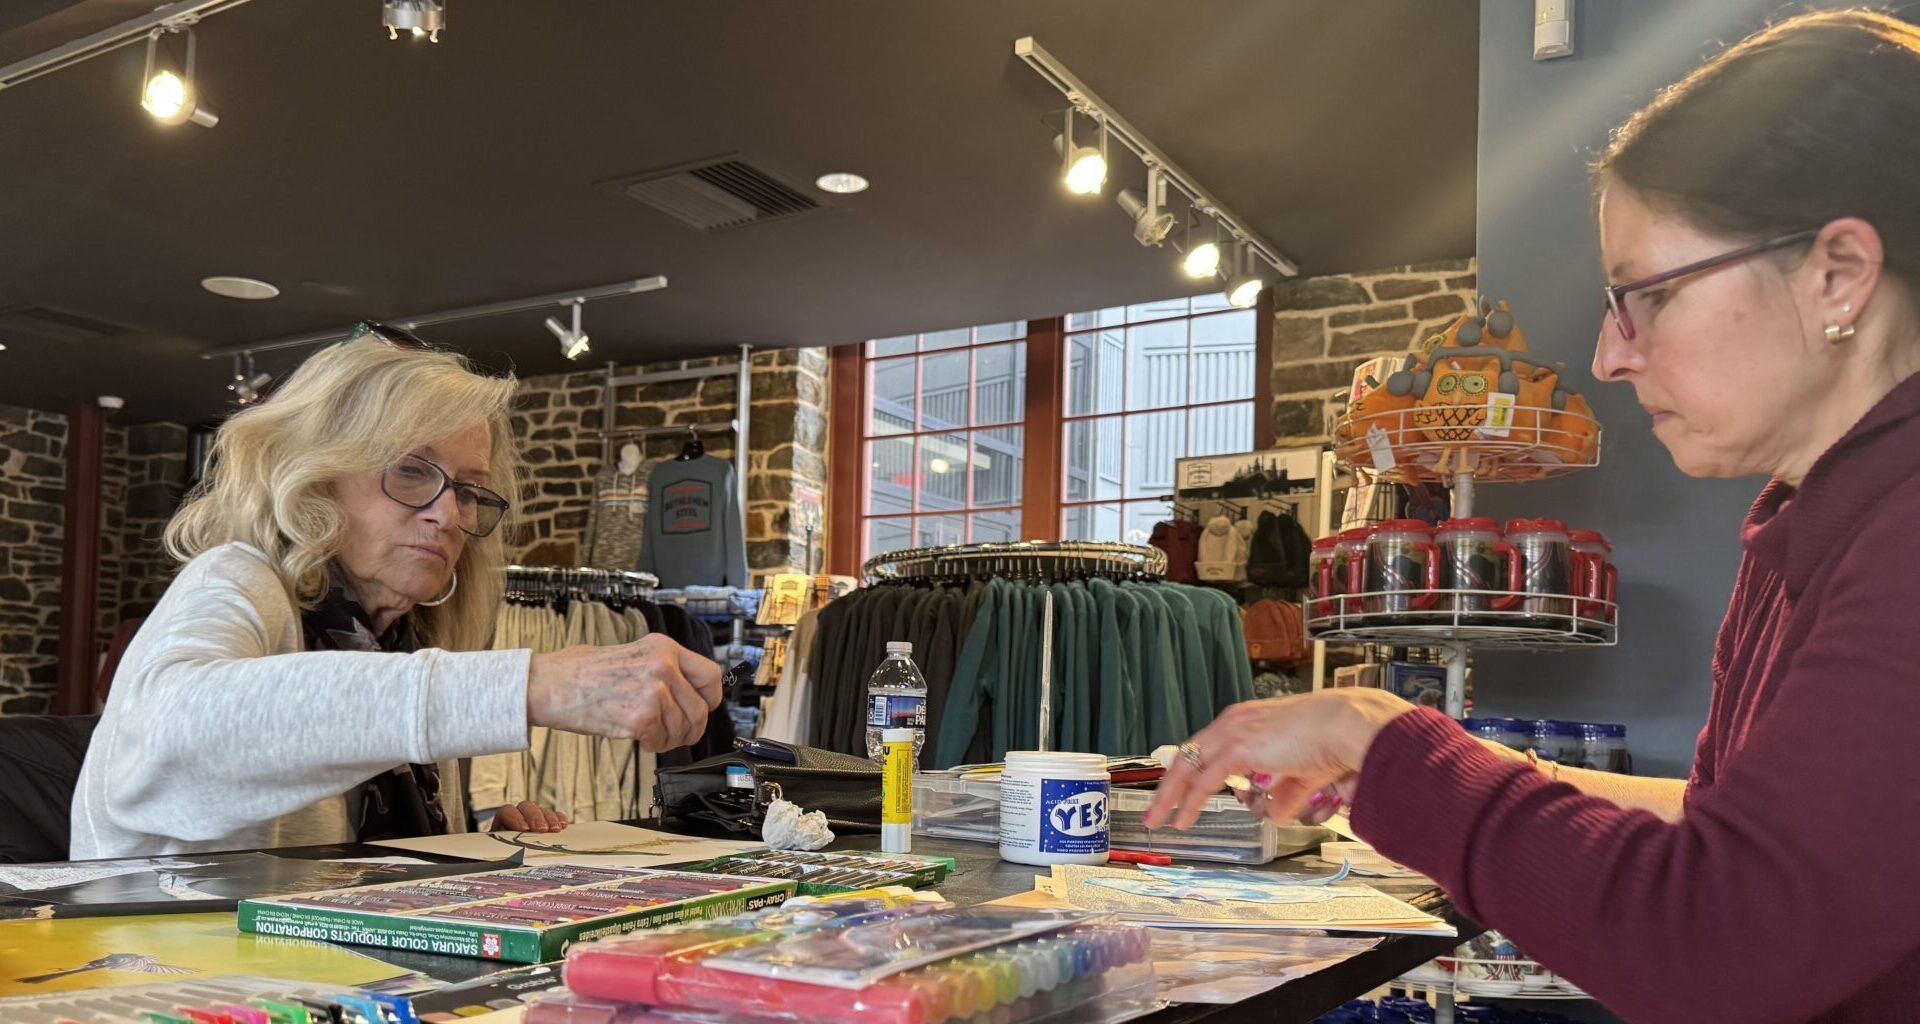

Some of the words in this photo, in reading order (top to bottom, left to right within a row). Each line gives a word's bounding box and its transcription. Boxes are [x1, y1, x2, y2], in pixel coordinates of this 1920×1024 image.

[1055, 797, 1107, 831] YES!
[255, 921, 328, 939] CORPORATION
[622, 921, 636, 931] Feine
[636, 917, 649, 928] Extra
[331, 930, 388, 946] PRODUCTS
[392, 935, 429, 950] COLOR
[432, 940, 478, 956] SAKURA
